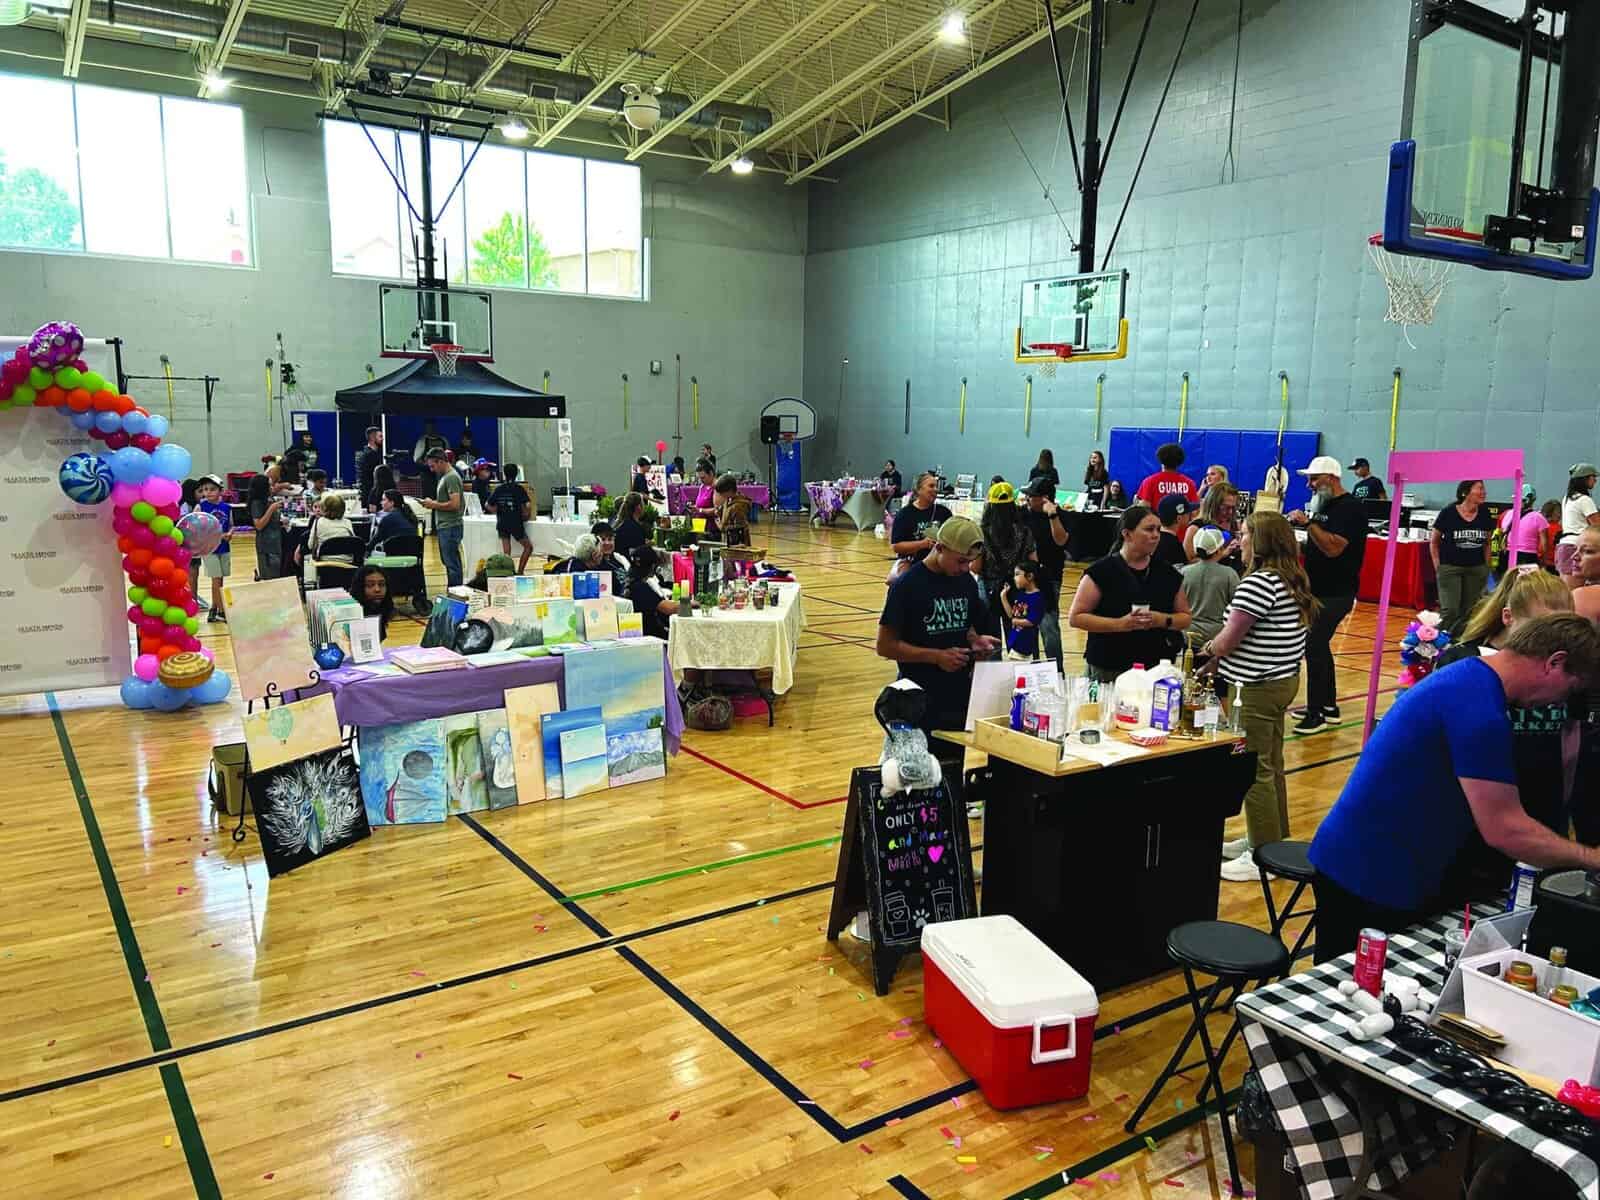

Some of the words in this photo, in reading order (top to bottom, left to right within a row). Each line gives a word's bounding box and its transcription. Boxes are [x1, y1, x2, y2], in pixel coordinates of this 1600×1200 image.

[1158, 481, 1189, 495] GUARD
[885, 810, 915, 829] ONLY
[888, 832, 912, 850] and
